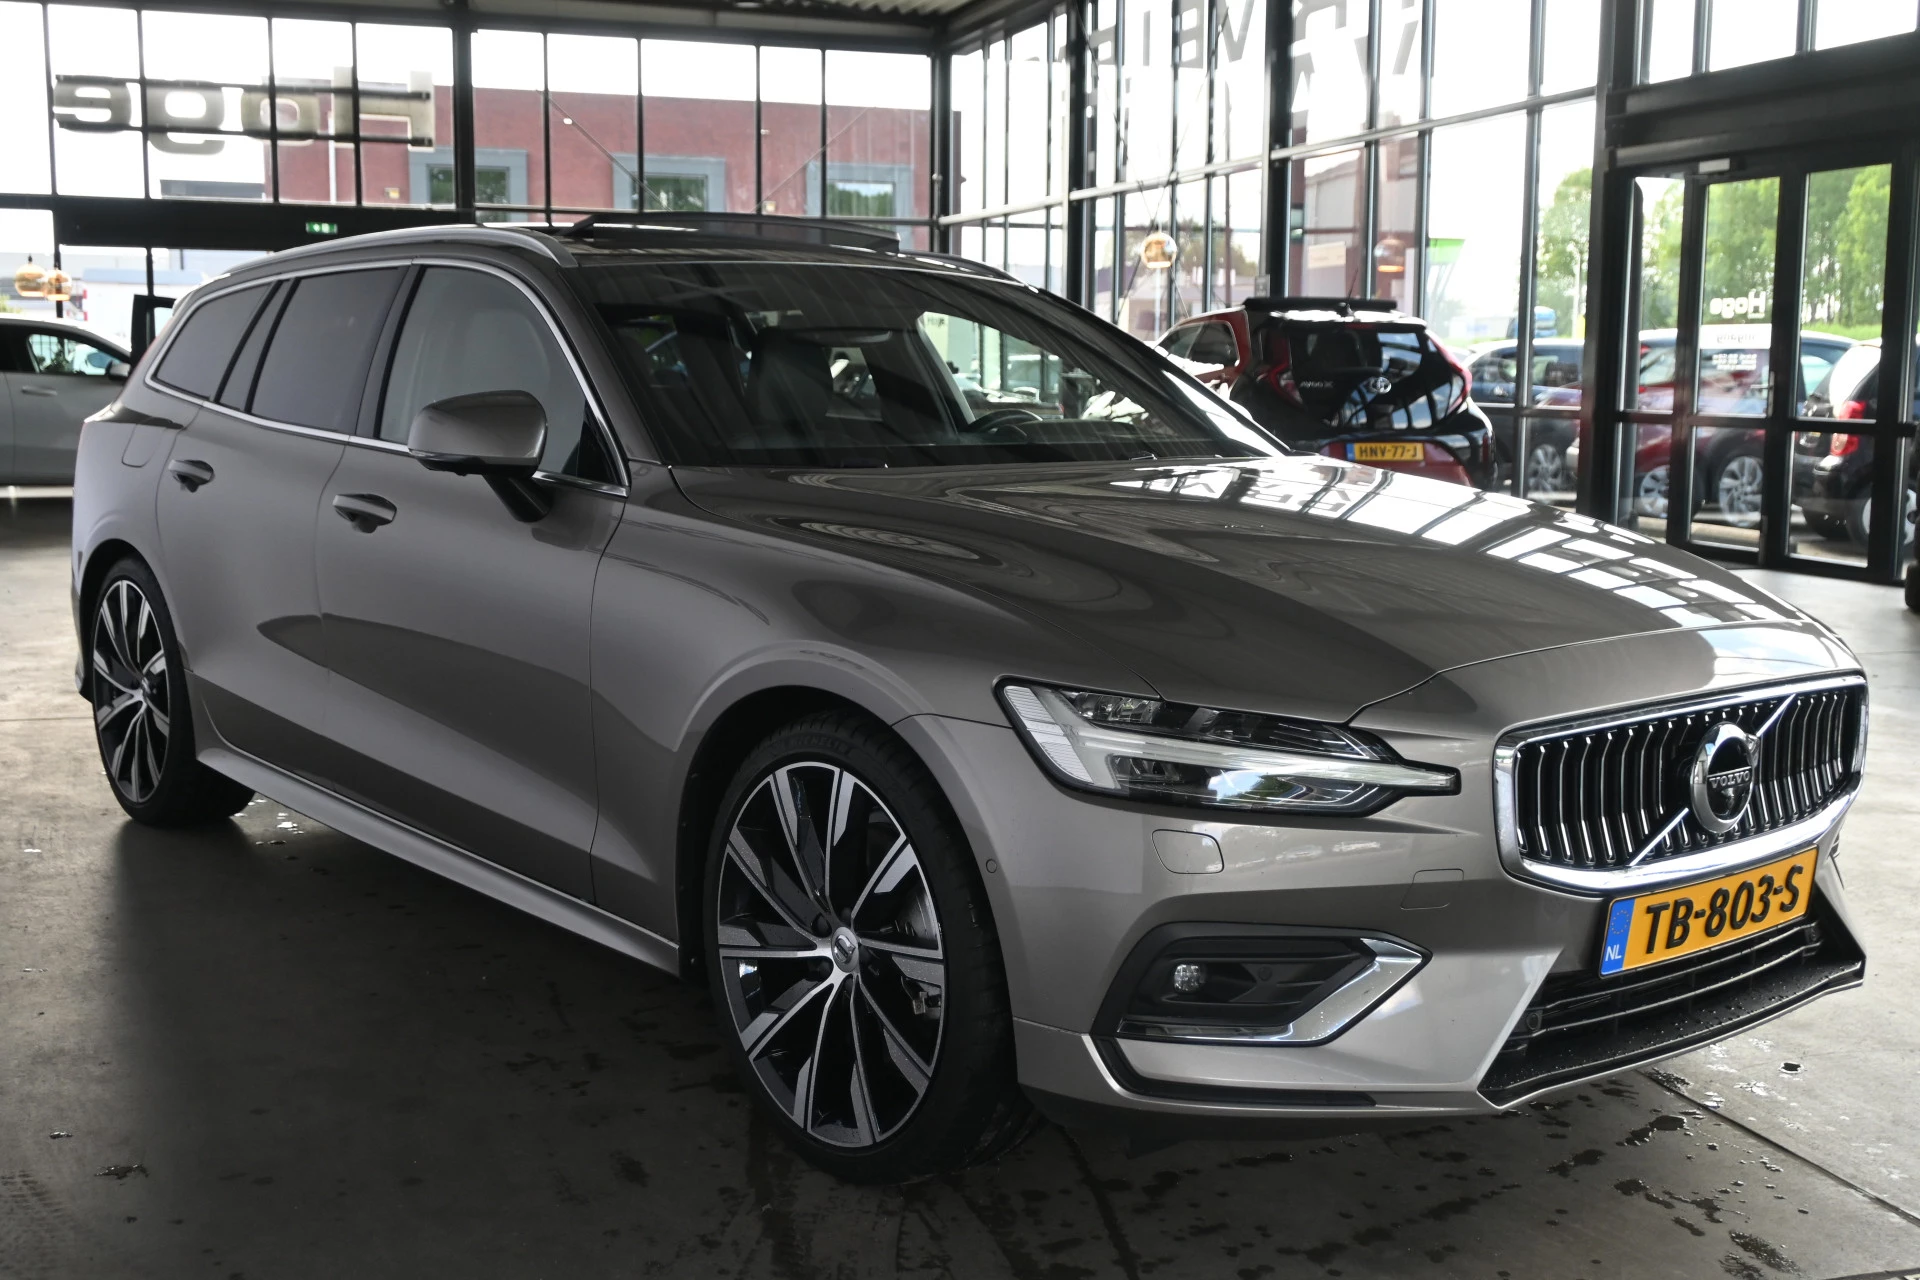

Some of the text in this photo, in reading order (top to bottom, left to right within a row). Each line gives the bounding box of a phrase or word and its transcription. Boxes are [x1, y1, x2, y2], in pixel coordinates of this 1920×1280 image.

[1359, 445, 1417, 458] HNV-77-J
[1709, 770, 1751, 789] VOLVO
[1646, 863, 1804, 954] TB-803-S
[1605, 944, 1622, 961] NL
